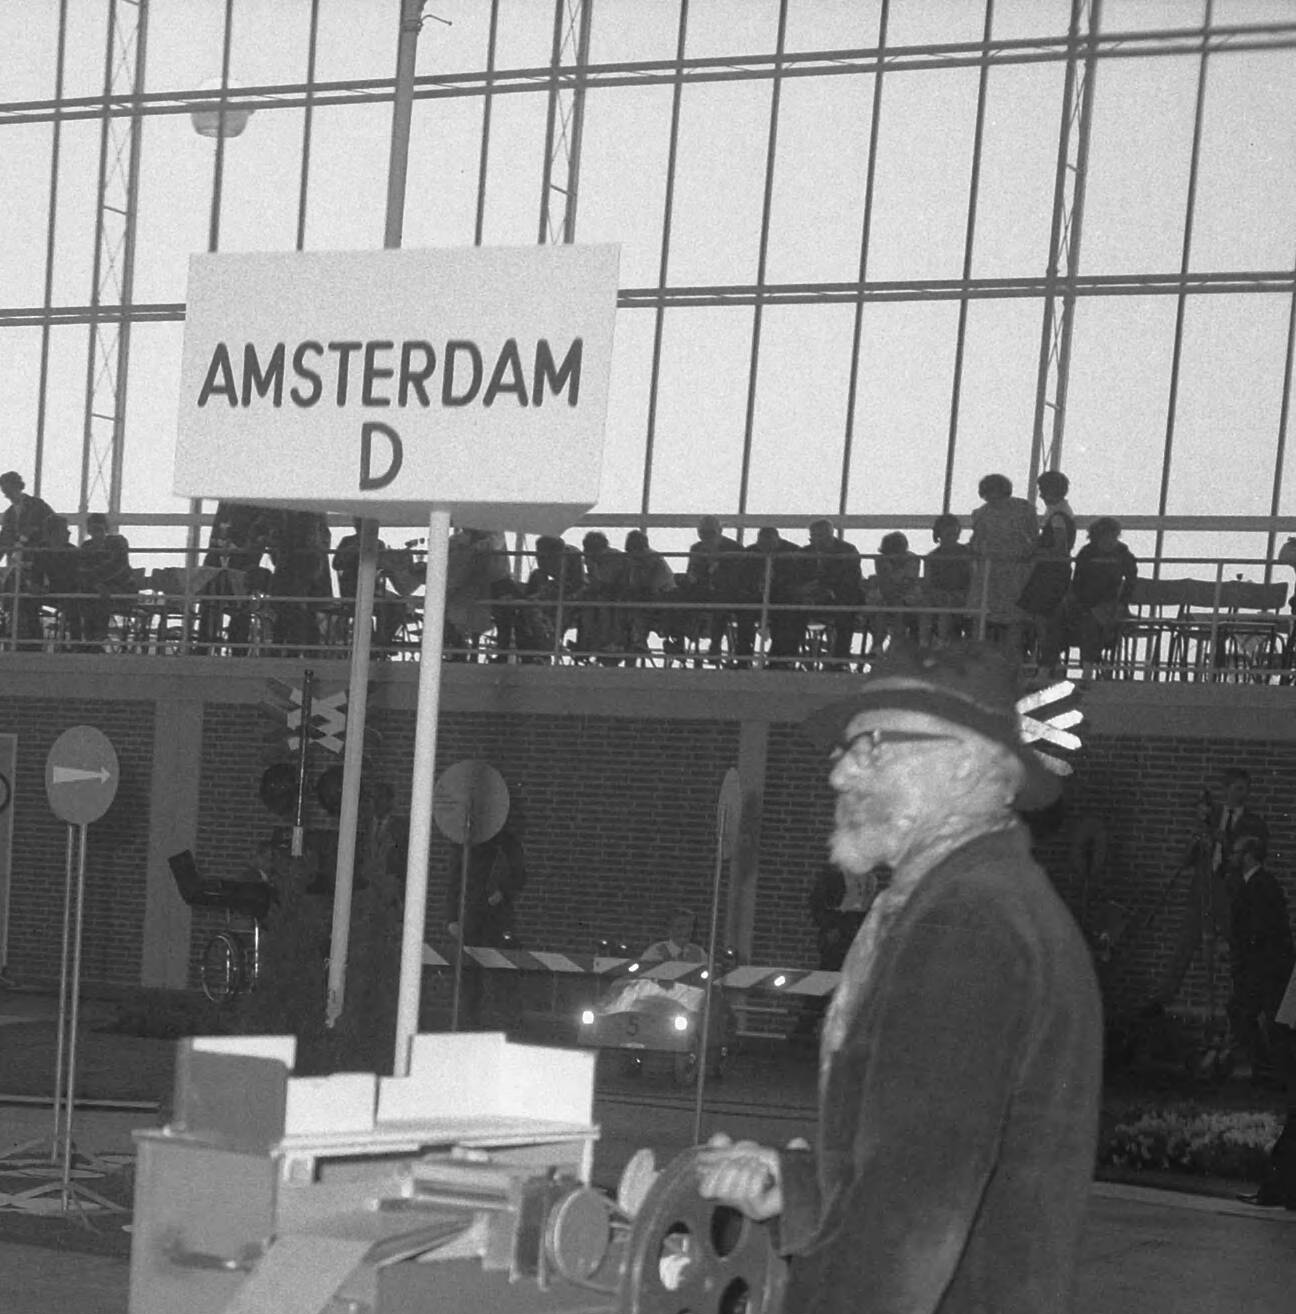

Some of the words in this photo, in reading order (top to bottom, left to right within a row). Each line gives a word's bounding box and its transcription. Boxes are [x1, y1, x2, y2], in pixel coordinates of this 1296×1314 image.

[197, 336, 584, 409] AMSTERDAM
[359, 420, 404, 492] D
[626, 1014, 641, 1037] 5
